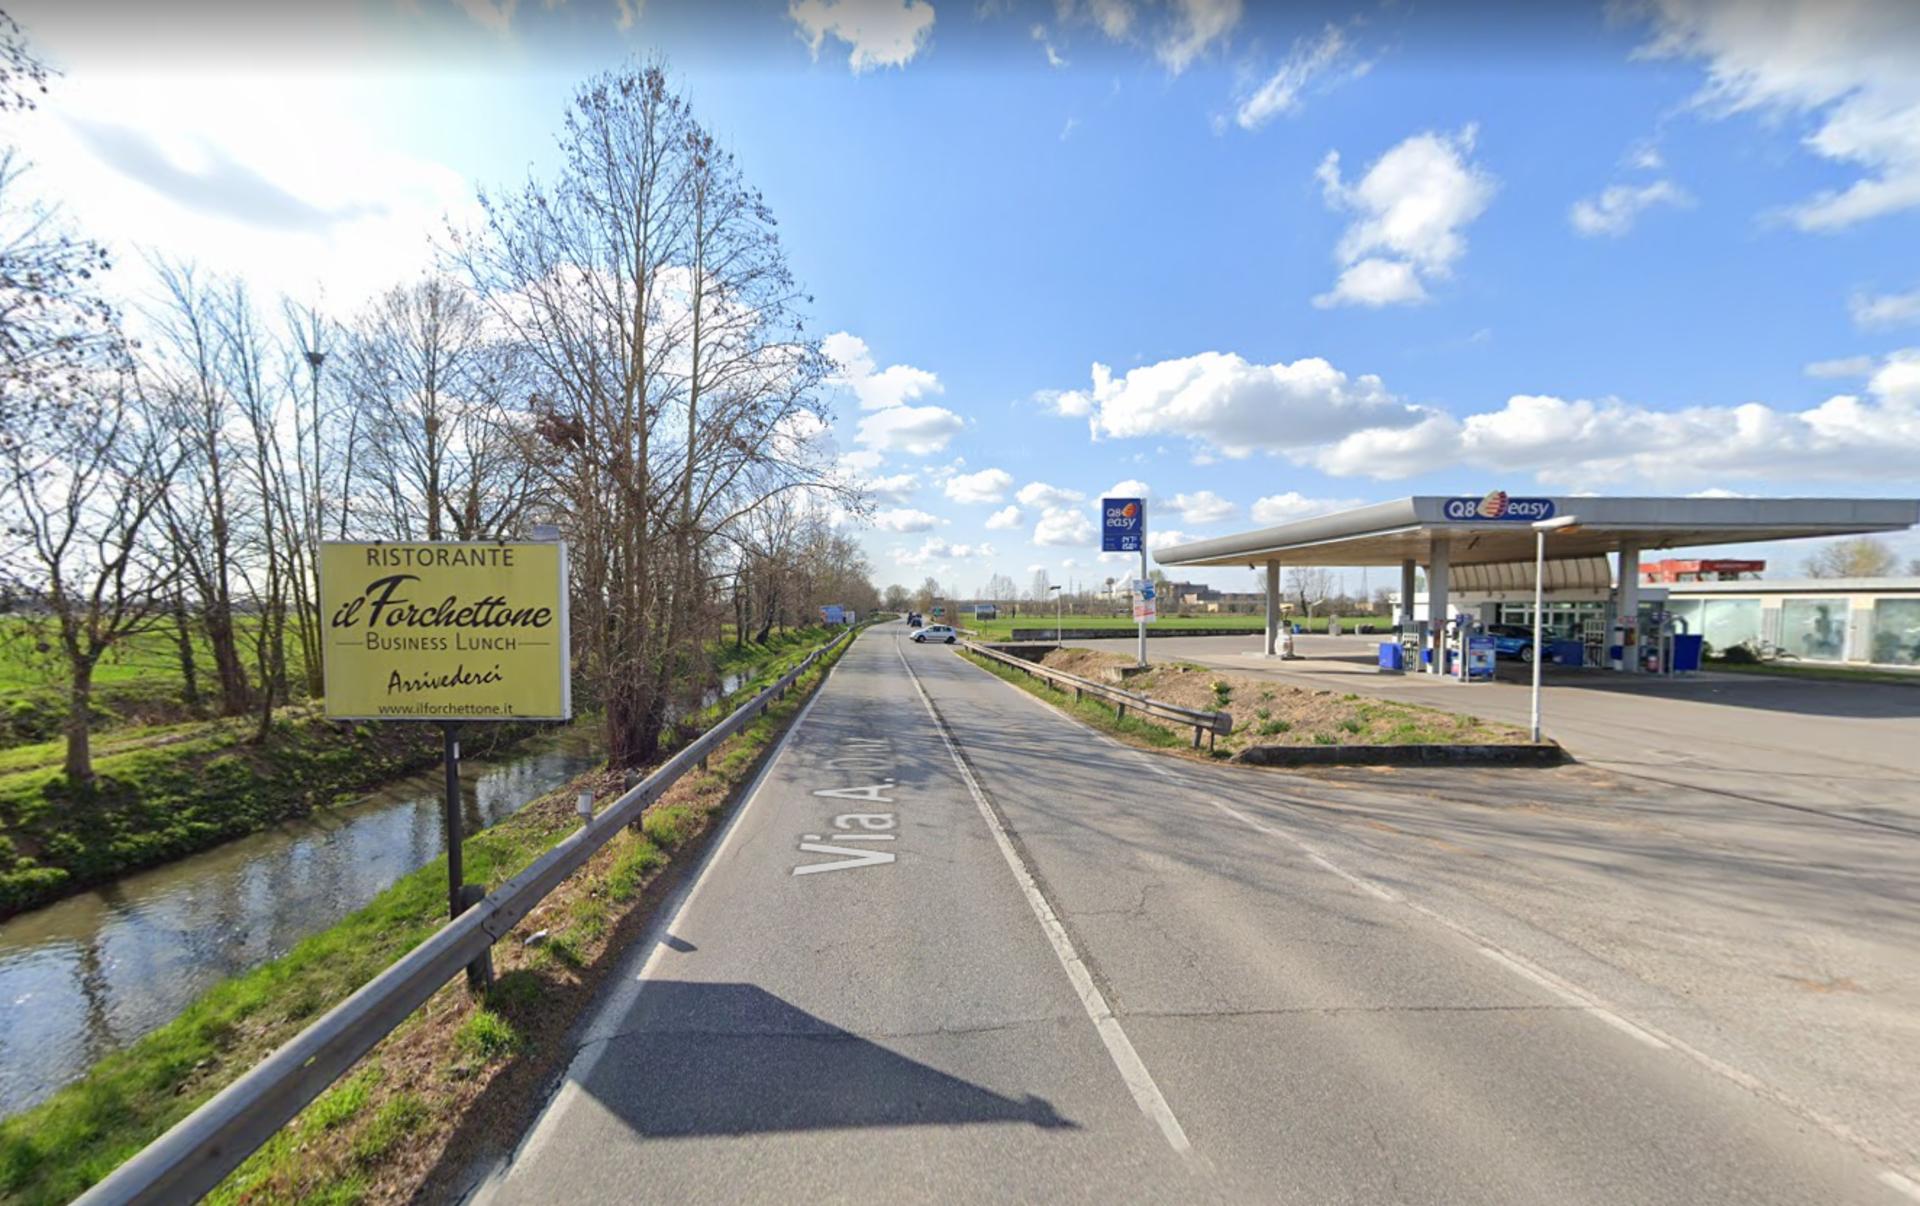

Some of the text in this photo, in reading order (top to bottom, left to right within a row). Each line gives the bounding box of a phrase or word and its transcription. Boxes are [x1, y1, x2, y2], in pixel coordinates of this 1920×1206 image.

[1106, 508, 1122, 518] Q8
[1448, 501, 1550, 519] Q8 easy
[1106, 518, 1137, 530] easy
[366, 548, 514, 567] RISTORANTE
[331, 574, 553, 629] il Forchettone
[386, 664, 504, 696] Arrivederci
[378, 702, 514, 716] www.ilforchettone.it
